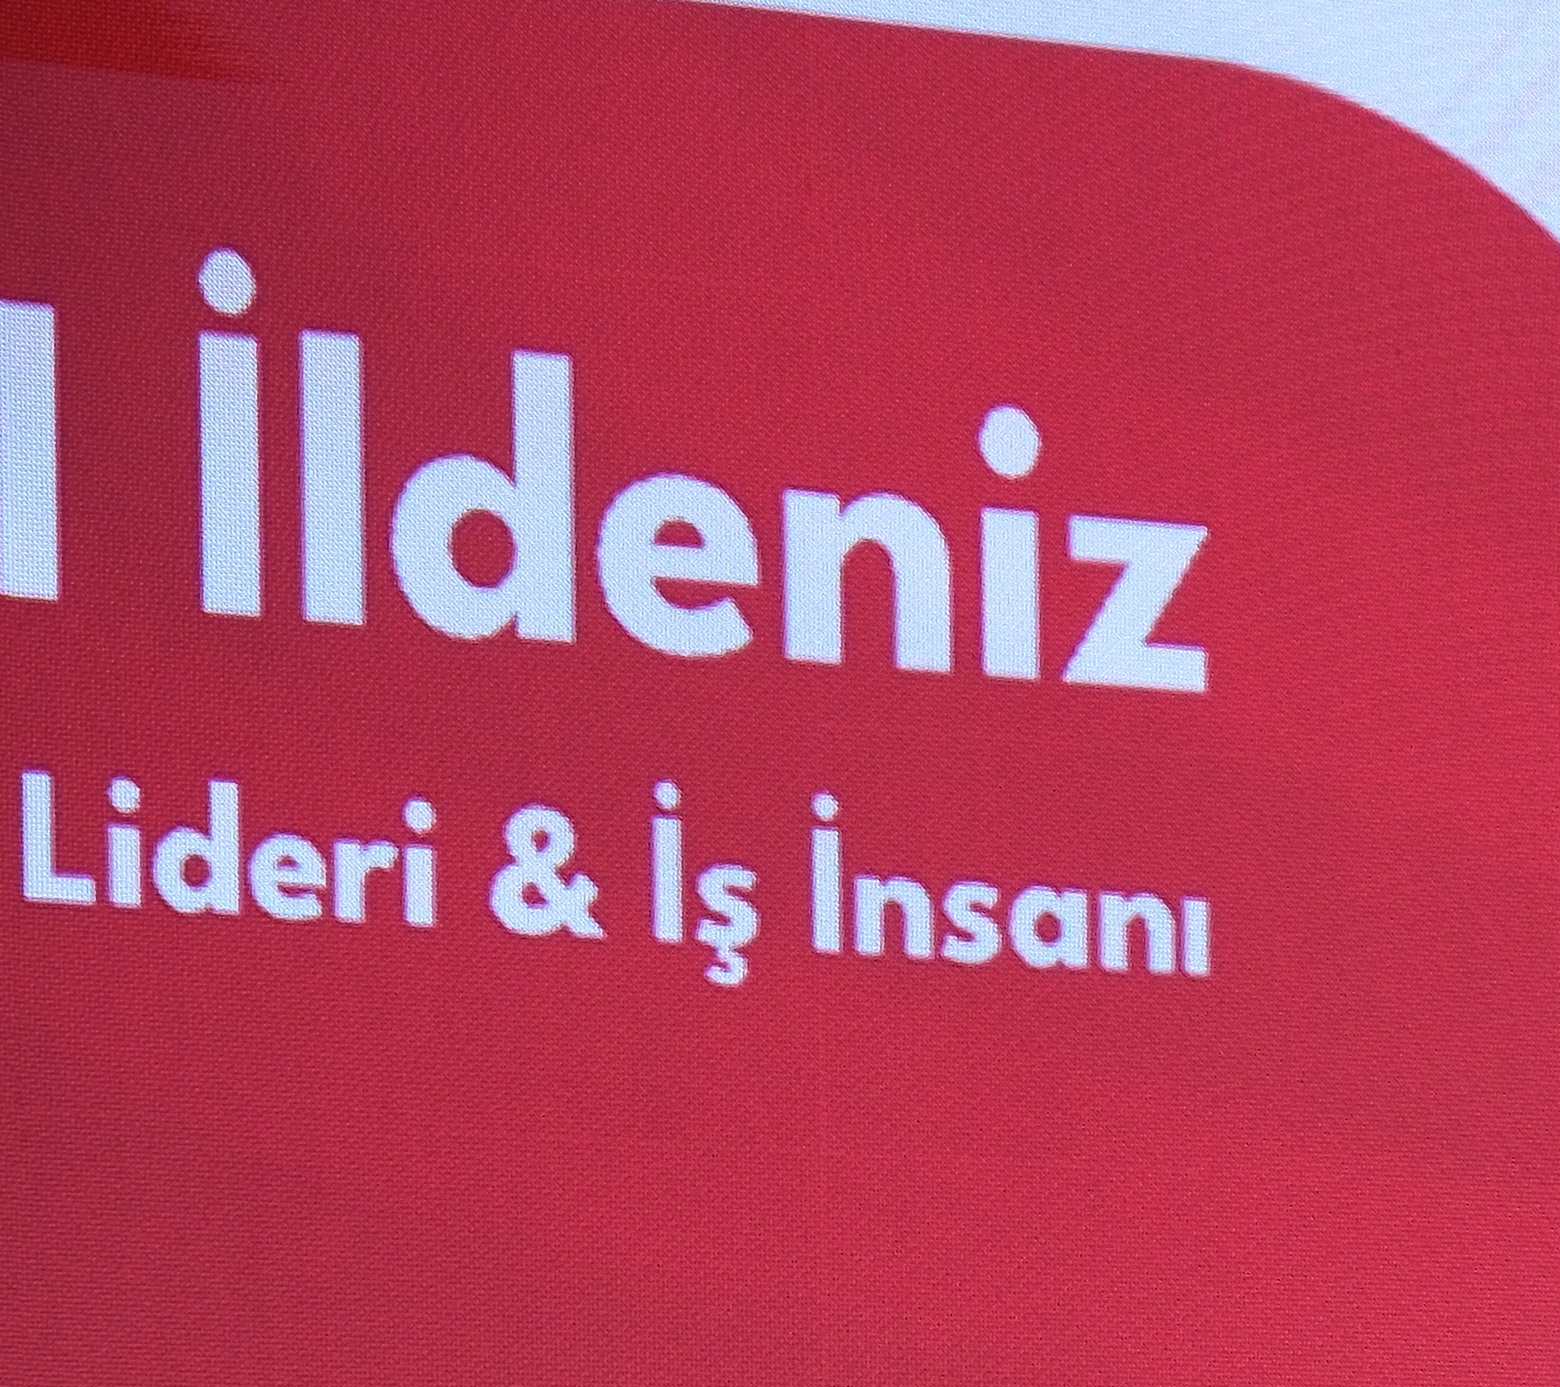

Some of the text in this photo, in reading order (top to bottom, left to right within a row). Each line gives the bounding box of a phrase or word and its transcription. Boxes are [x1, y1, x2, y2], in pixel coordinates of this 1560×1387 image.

[198, 246, 1209, 693] İldeniz
[20, 770, 1211, 984] Lideri & İş İnsanı
